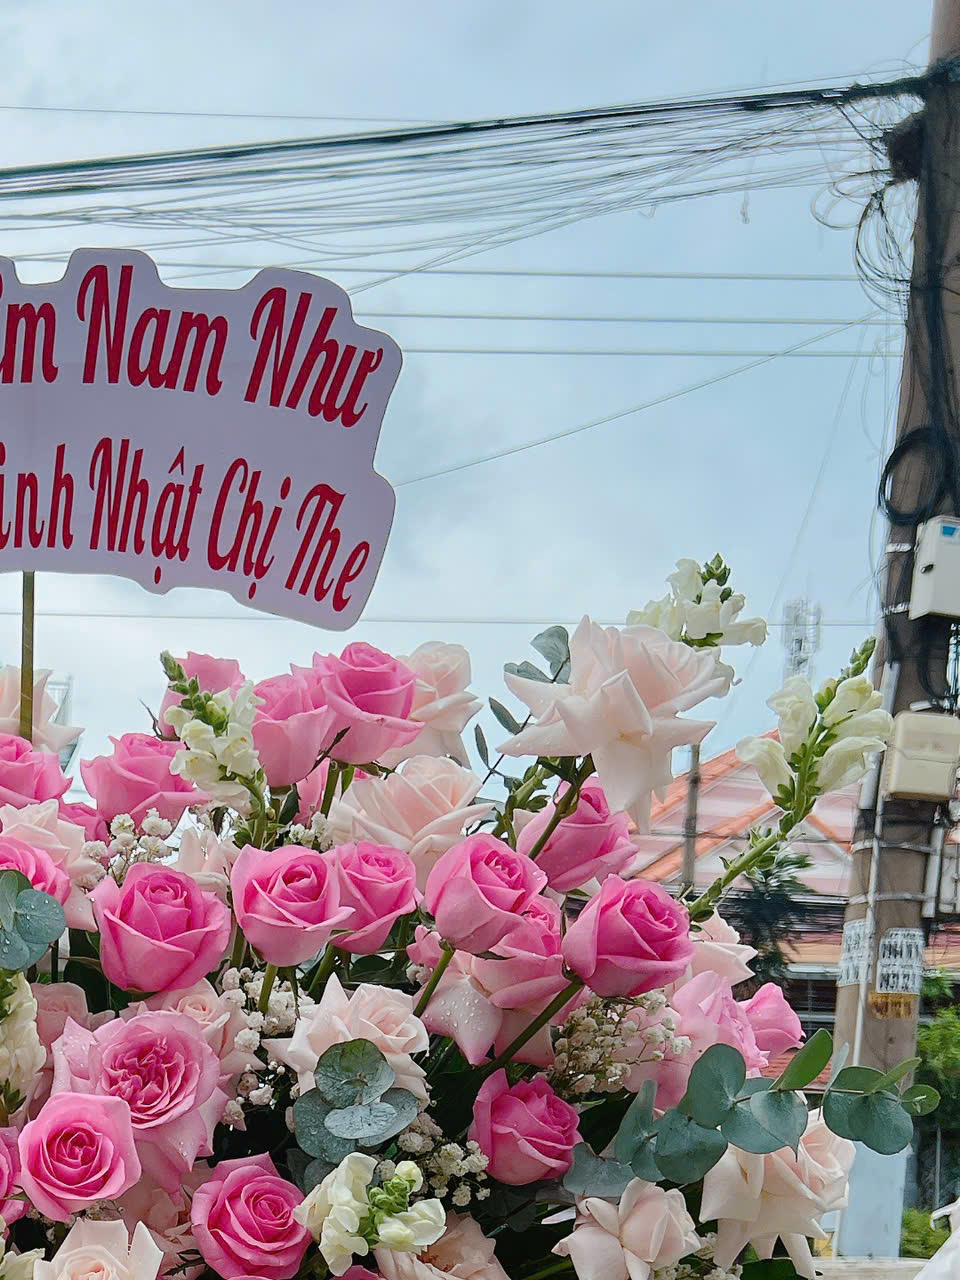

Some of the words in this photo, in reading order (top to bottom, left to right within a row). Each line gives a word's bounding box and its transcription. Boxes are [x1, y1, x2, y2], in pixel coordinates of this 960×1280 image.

[76, 264, 229, 395] Nam
[245, 287, 381, 427] Như
[89, 437, 203, 584] Nhật
[207, 457, 282, 598] Chị
[285, 483, 370, 612] The
